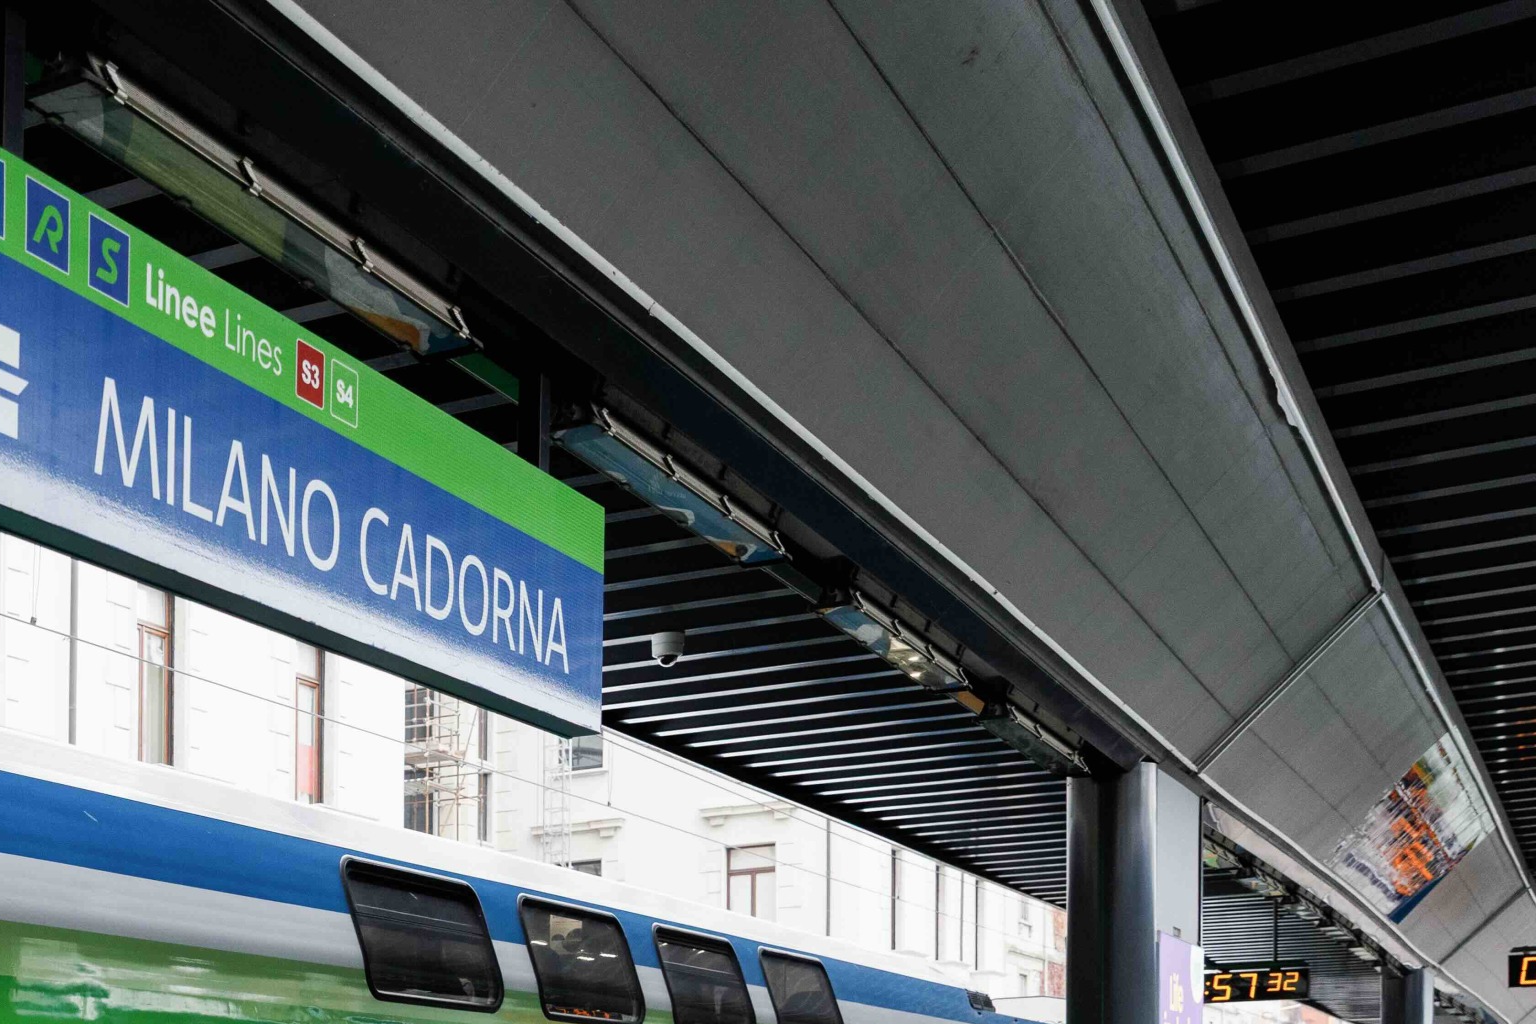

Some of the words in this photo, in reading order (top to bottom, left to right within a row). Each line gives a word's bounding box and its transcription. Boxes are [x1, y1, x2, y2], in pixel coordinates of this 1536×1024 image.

[32, 205, 64, 254] R
[95, 237, 121, 285] S
[145, 262, 216, 338] Linee
[225, 308, 282, 377] Lines
[301, 359, 320, 390] S3
[336, 379, 354, 409] S4
[93, 376, 341, 572] MILANO
[360, 507, 570, 674] CADORNA
[1266, 971, 1299, 992] 32
